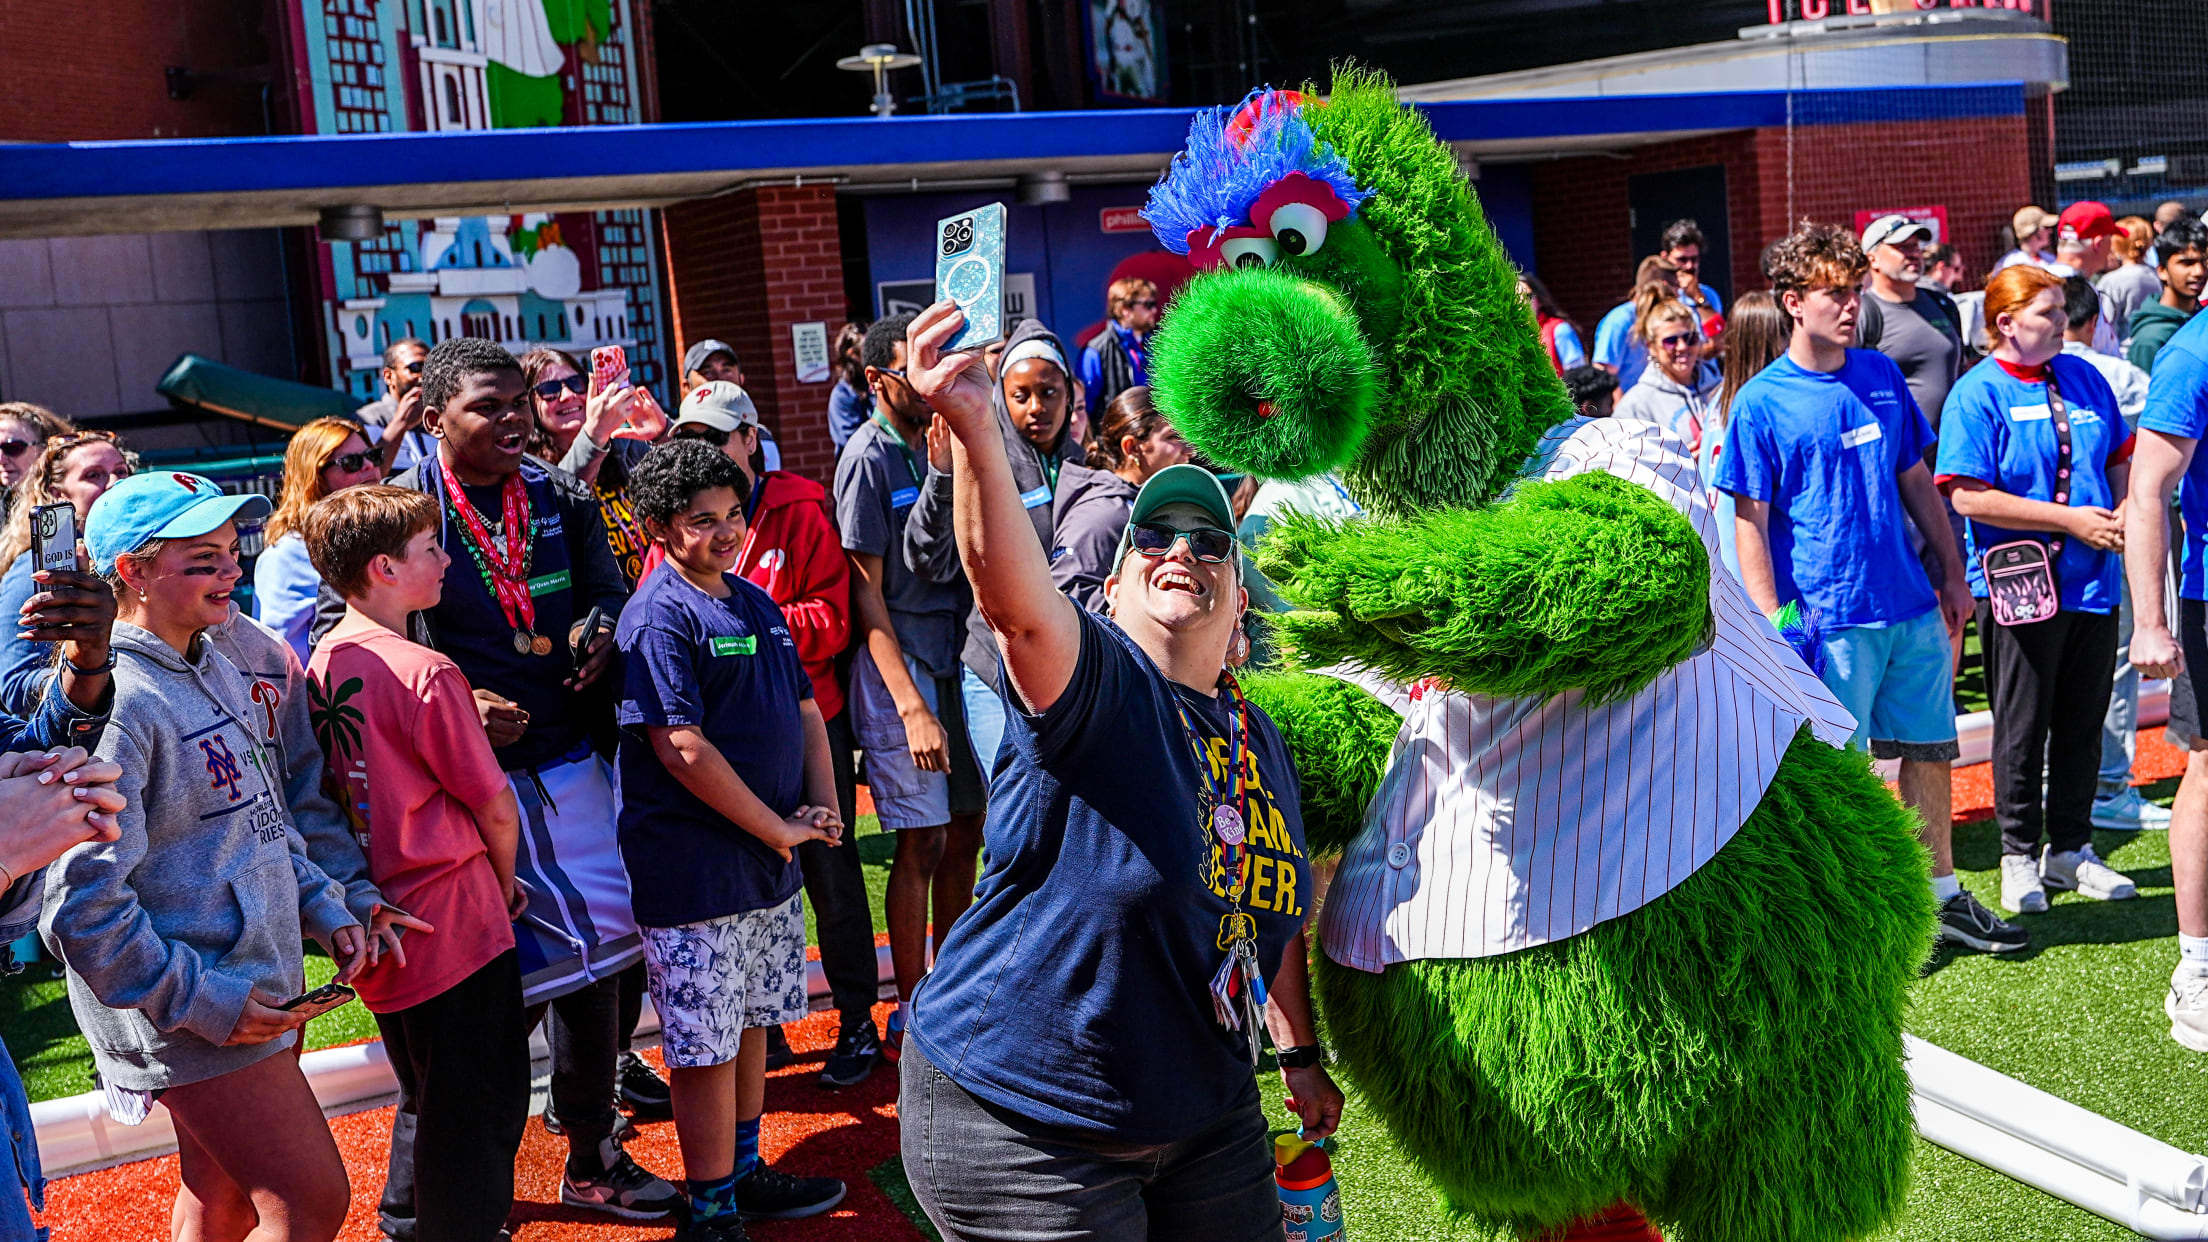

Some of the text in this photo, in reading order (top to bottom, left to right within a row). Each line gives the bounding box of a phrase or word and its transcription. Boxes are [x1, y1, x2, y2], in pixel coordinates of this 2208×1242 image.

[696, 389, 712, 404] P
[45, 549, 73, 563] GOD IS
[250, 679, 280, 740] P
[1215, 815, 1231, 829] Be
[1222, 819, 1245, 842] Kind
[260, 823, 285, 844] RIES
